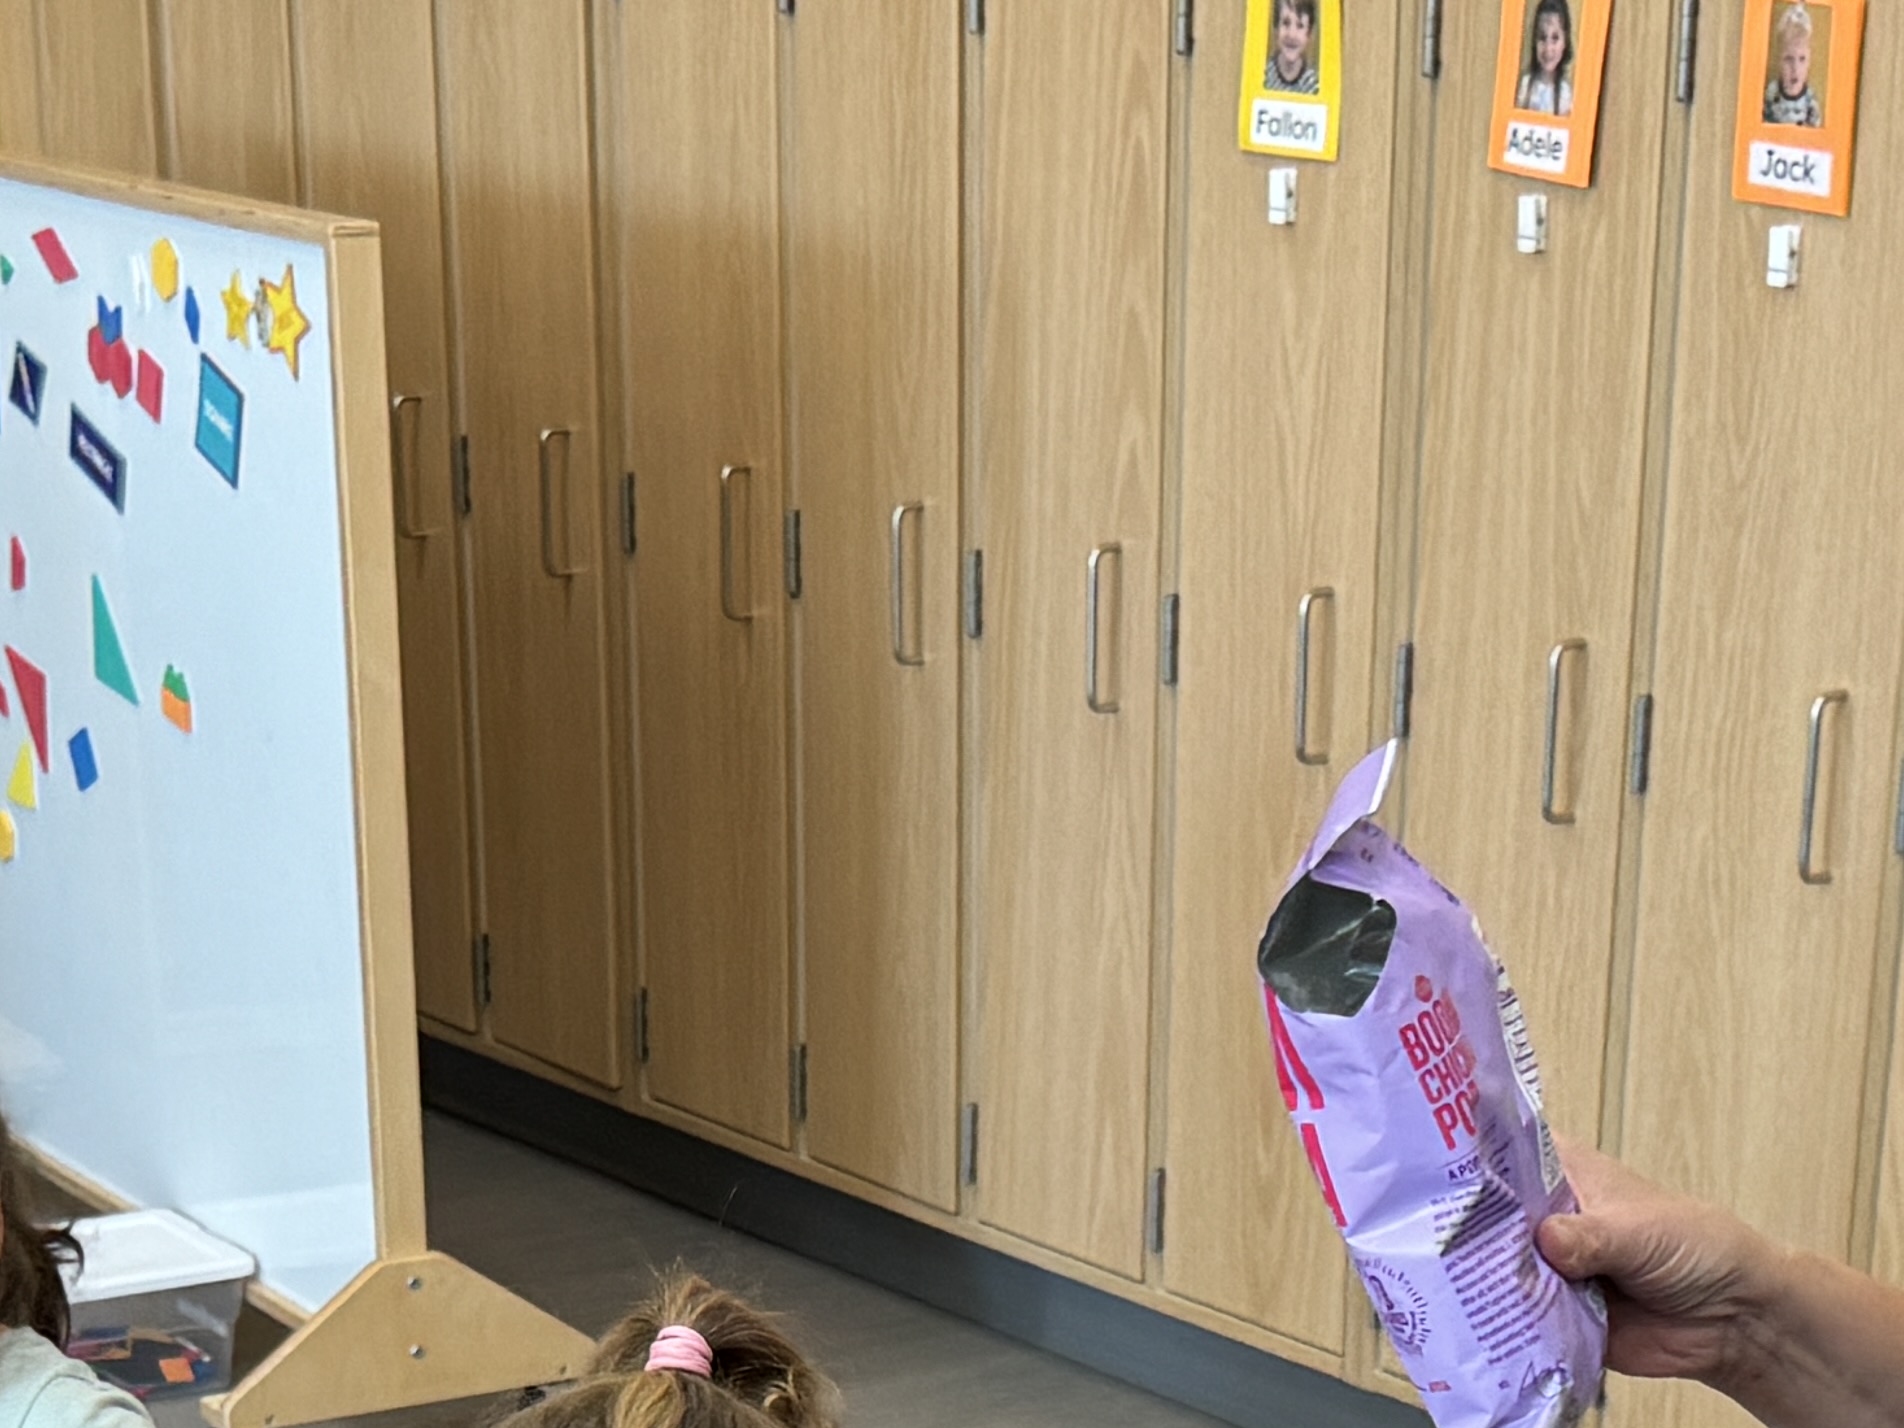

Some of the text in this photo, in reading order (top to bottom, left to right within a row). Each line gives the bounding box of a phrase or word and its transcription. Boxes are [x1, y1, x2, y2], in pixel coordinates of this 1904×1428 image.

[1256, 109, 1317, 142] Fallon
[1508, 128, 1564, 161] Adele
[1759, 149, 1815, 185] Jack
